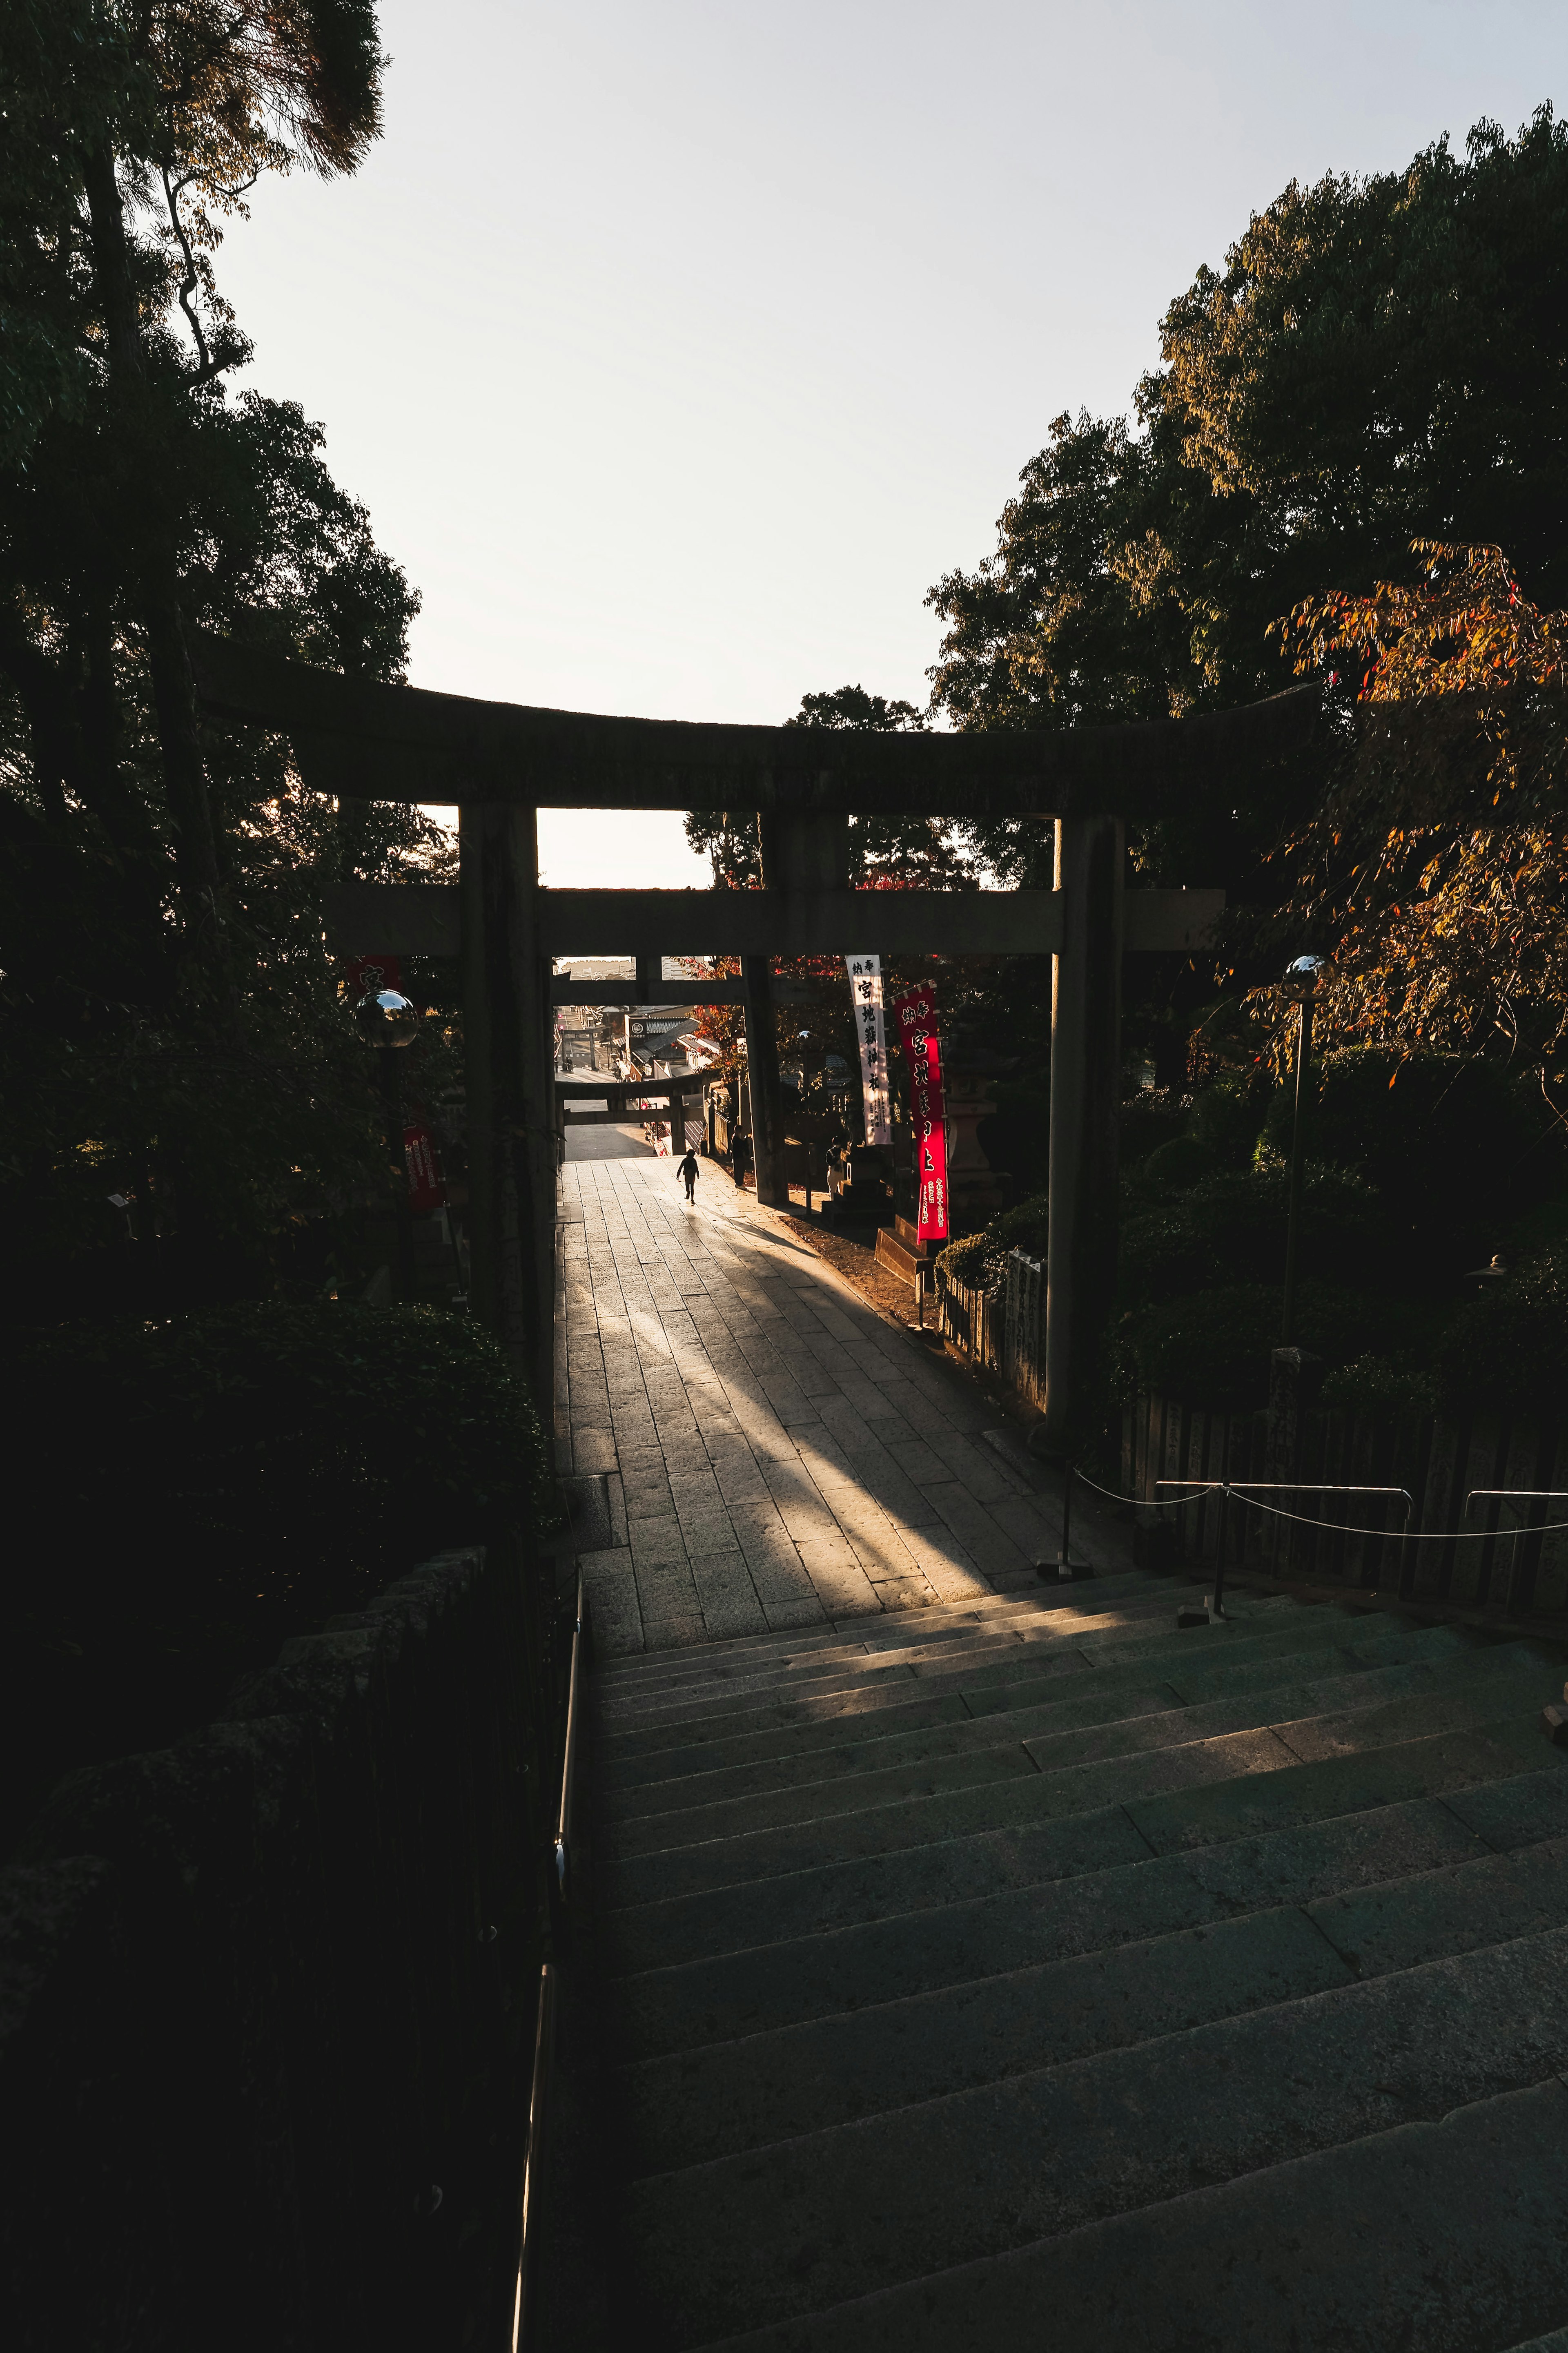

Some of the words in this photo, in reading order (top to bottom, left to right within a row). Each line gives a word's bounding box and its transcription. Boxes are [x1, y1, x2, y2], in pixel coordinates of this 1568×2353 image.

[852, 960, 873, 975] 奉納
[902, 1001, 929, 1025] 奉納
[858, 980, 880, 1092] 宮地嶽神社
[936, 1178, 944, 1227] 令和三年十二月五日
